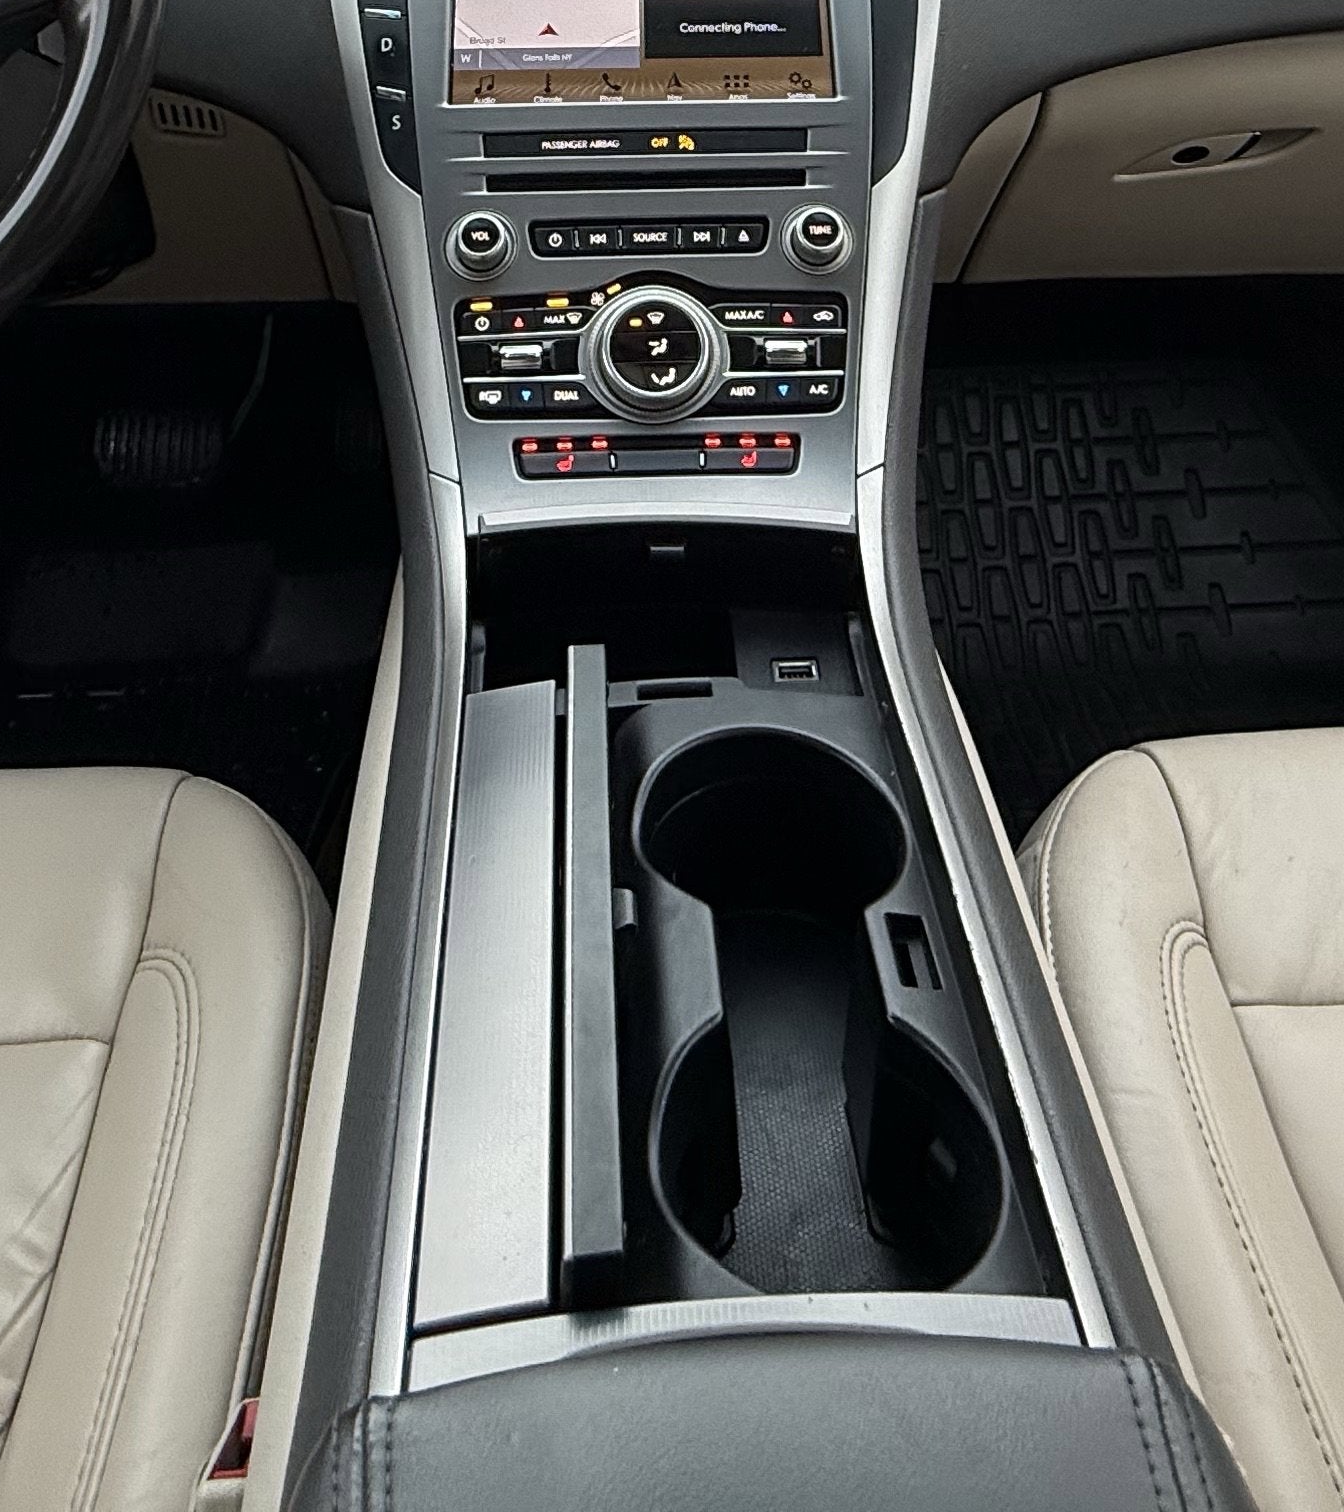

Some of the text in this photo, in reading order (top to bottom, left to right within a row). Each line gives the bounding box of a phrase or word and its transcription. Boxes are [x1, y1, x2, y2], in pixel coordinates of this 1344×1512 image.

[679, 22, 742, 34] Connecting
[381, 37, 393, 52] D
[460, 53, 472, 63] W
[391, 114, 402, 130] S
[541, 139, 620, 150] PASSENGER AIRBAG
[651, 136, 669, 149] OFF
[808, 224, 833, 235] TUNE
[470, 230, 491, 242] VOL
[632, 231, 669, 243] SOURCE
[543, 315, 565, 325] MAX
[554, 390, 580, 401] DUAL
[729, 385, 757, 397] AUTO
[809, 384, 830, 395] A/C
